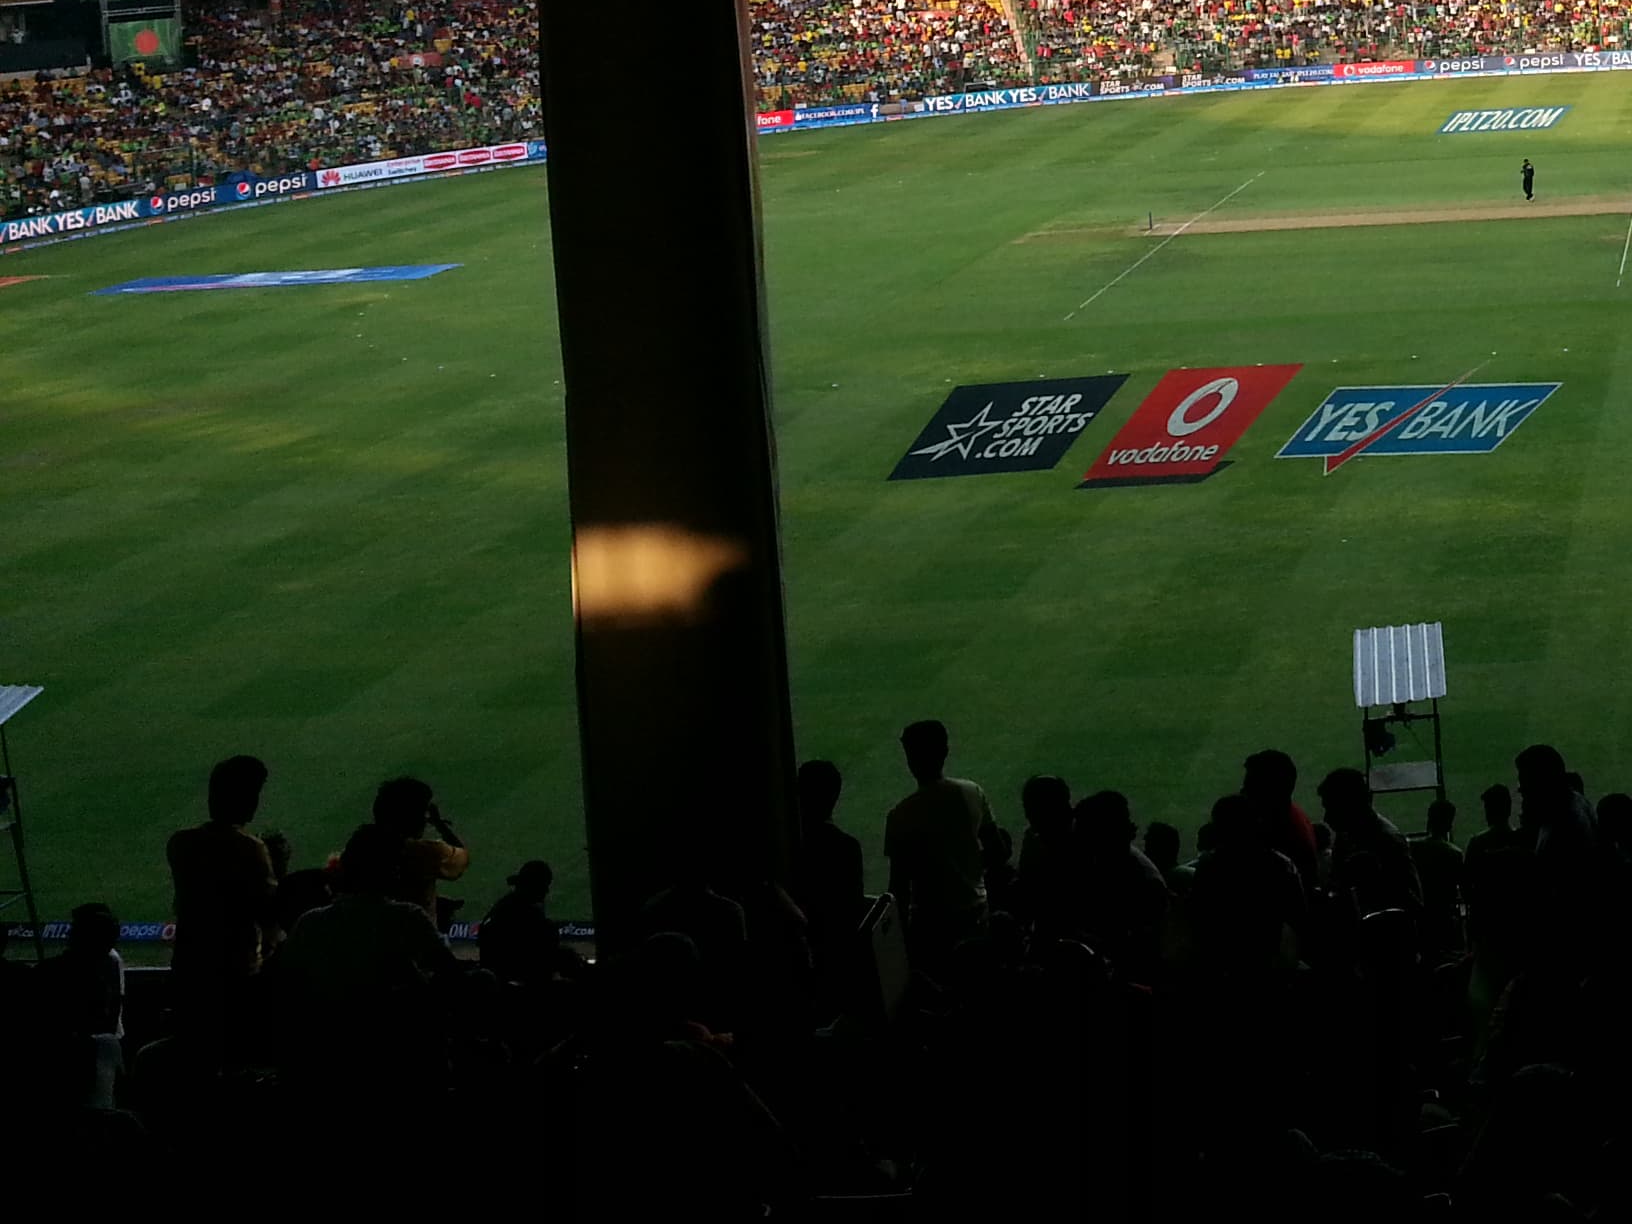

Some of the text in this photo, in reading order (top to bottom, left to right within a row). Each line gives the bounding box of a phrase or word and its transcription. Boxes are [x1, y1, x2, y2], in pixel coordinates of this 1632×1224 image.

[1440, 57, 1484, 73] pepsi
[1520, 54, 1564, 68] pepsi
[1573, 53, 1600, 66] YES
[1358, 64, 1404, 75] vodafone
[1100, 80, 1120, 88] STAR
[1143, 83, 1165, 91] .COM
[1181, 79, 1212, 88] SPORTS
[1224, 77, 1245, 85] .COM
[926, 83, 1089, 111] YES BANK YES BANK
[1100, 85, 1130, 94] SPORTS
[757, 113, 781, 125] fone
[1442, 107, 1564, 132] IPLT20.COM
[343, 168, 383, 181] HUAWEI
[254, 175, 307, 197] pepsi
[167, 187, 216, 212] pepsi
[9, 201, 139, 241] BANK YES BANK
[1013, 393, 1082, 416] STAR
[993, 412, 1095, 439] SPORTS
[1303, 398, 1536, 443] YES BANK
[975, 436, 1042, 458] .COM
[1108, 440, 1219, 465] vodafone
